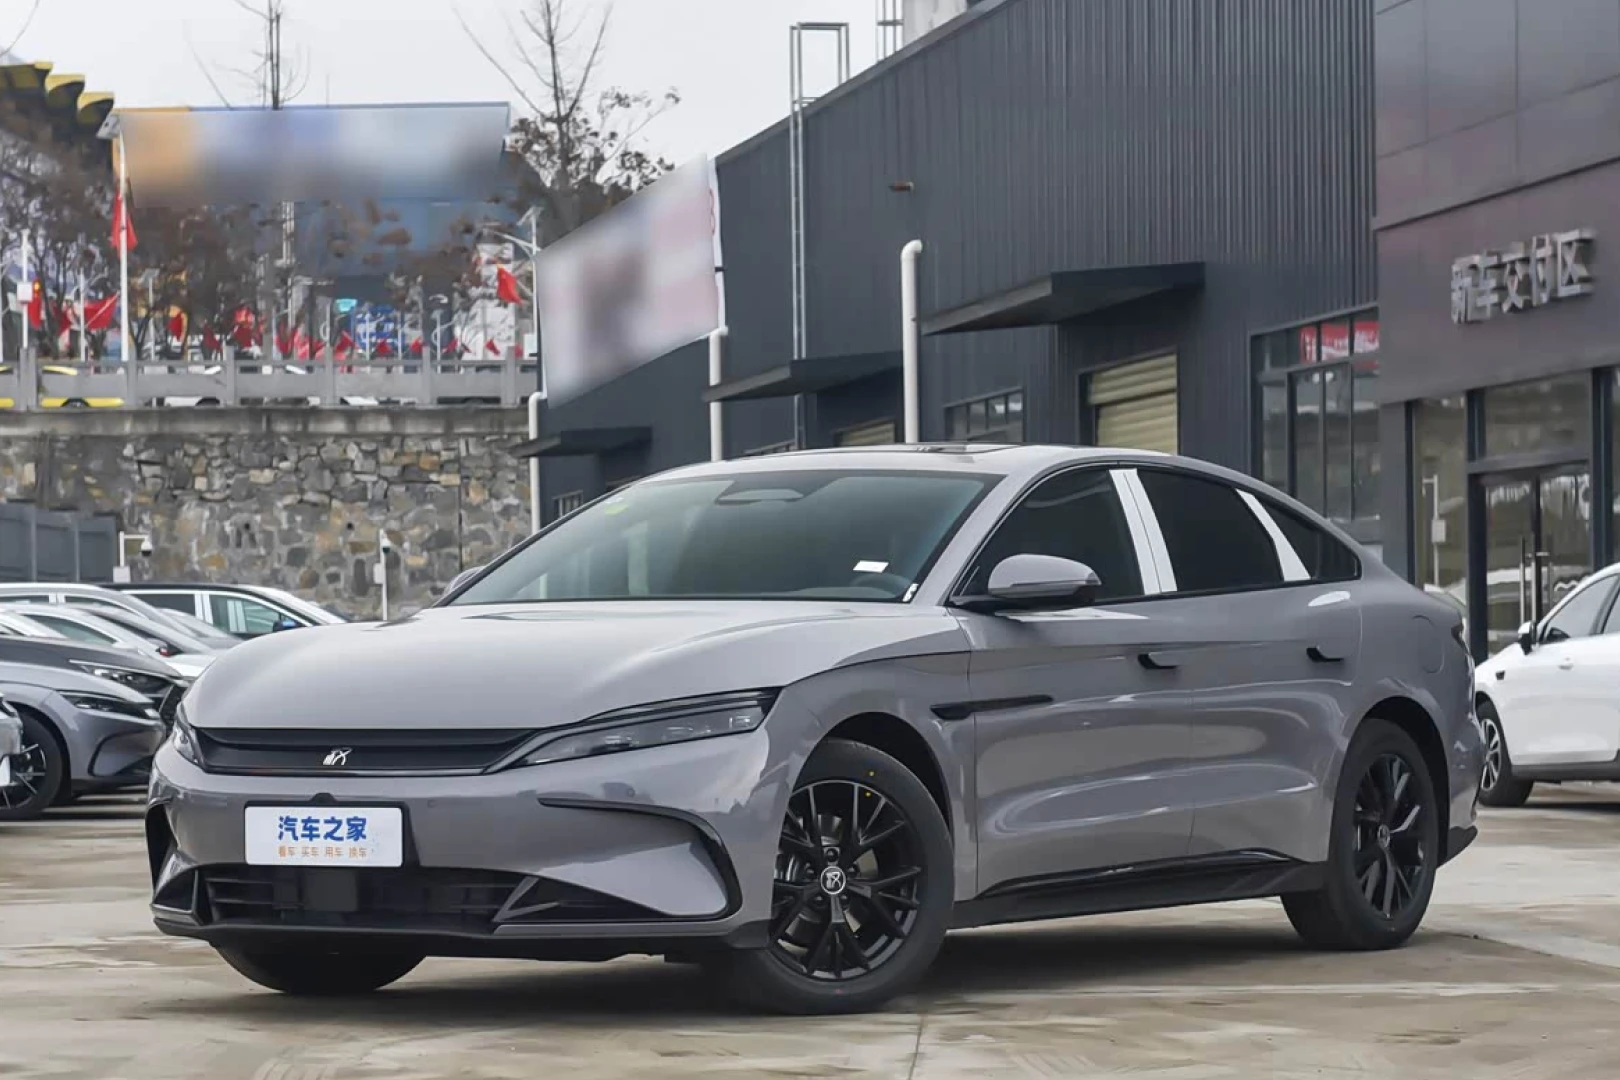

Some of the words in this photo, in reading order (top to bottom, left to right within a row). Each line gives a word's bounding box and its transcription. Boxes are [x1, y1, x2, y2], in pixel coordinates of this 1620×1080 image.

[1451, 229, 1595, 324] 新车交付区
[278, 815, 367, 842] 汽车之家
[325, 846, 344, 858] 用车
